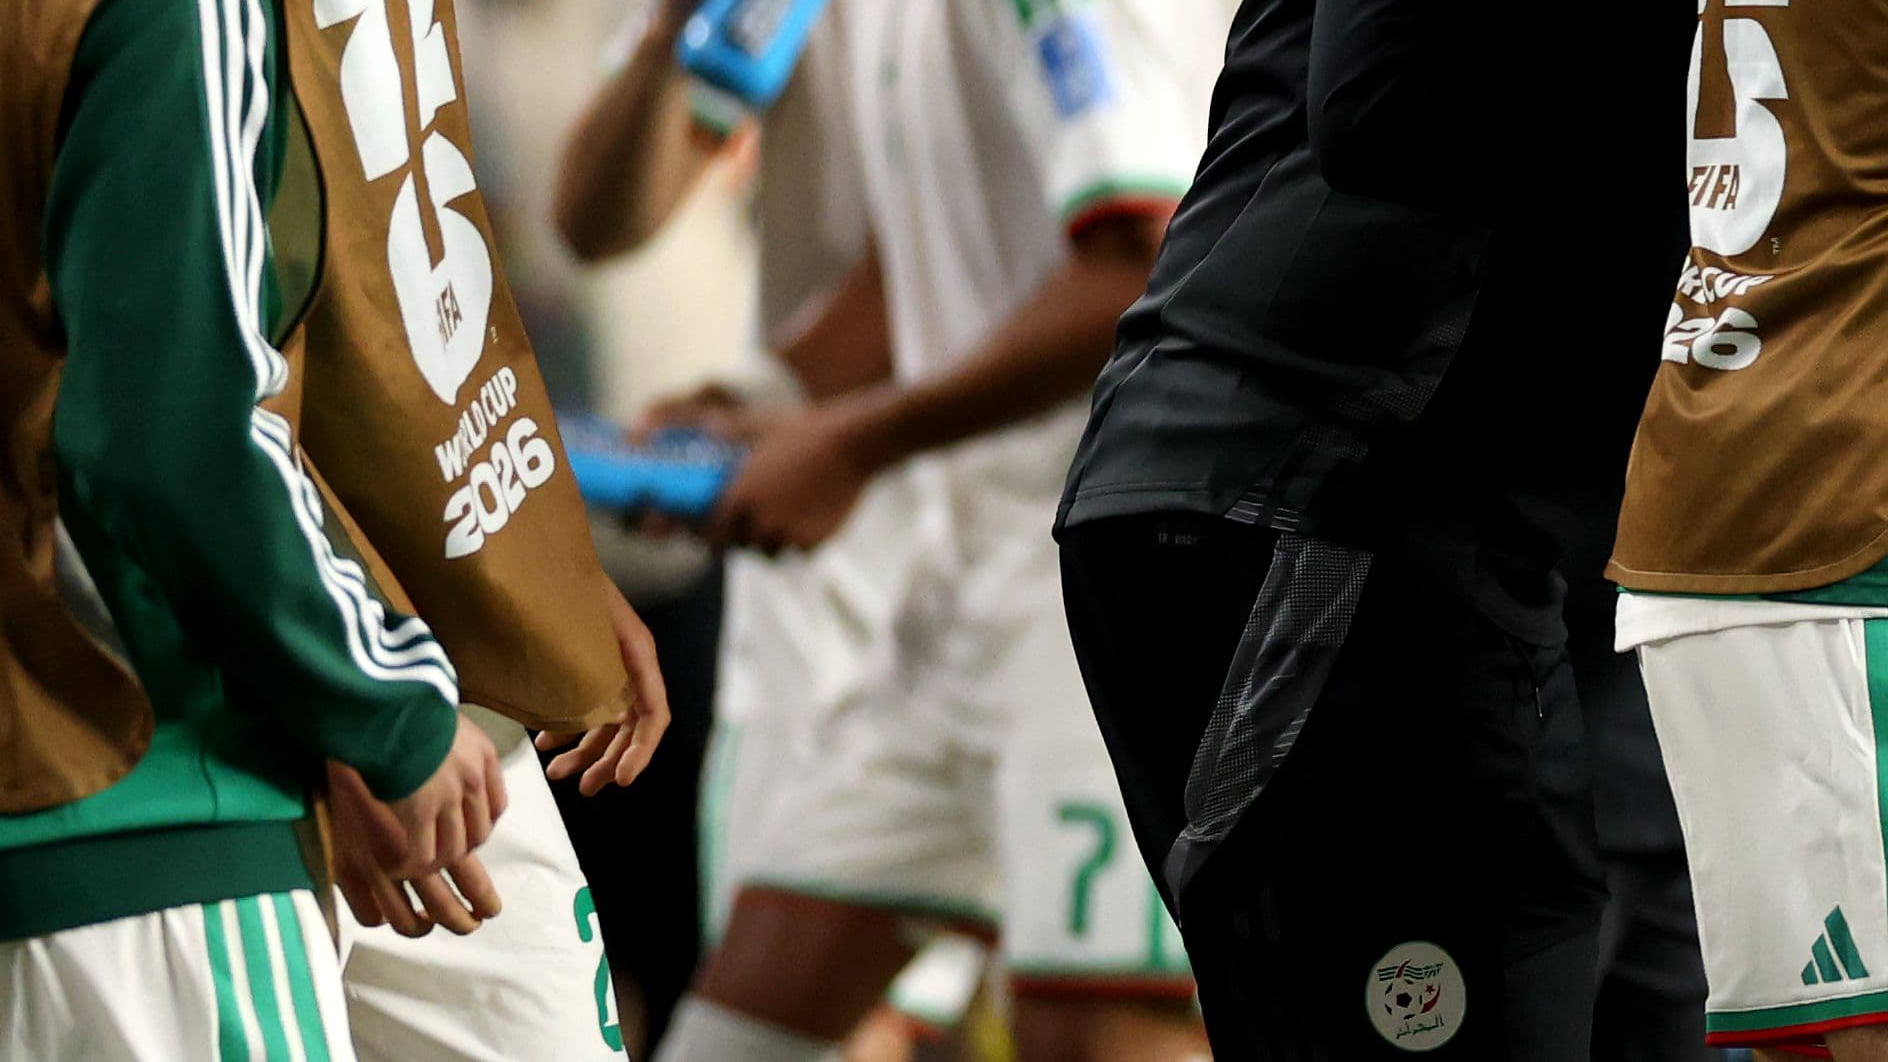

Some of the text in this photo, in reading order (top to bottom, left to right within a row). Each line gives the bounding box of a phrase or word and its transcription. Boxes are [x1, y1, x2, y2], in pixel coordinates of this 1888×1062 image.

[1661, 302, 1762, 370] 26
[480, 366, 517, 427] CUP
[443, 417, 556, 560] 2026
[1056, 801, 1118, 934] 7
